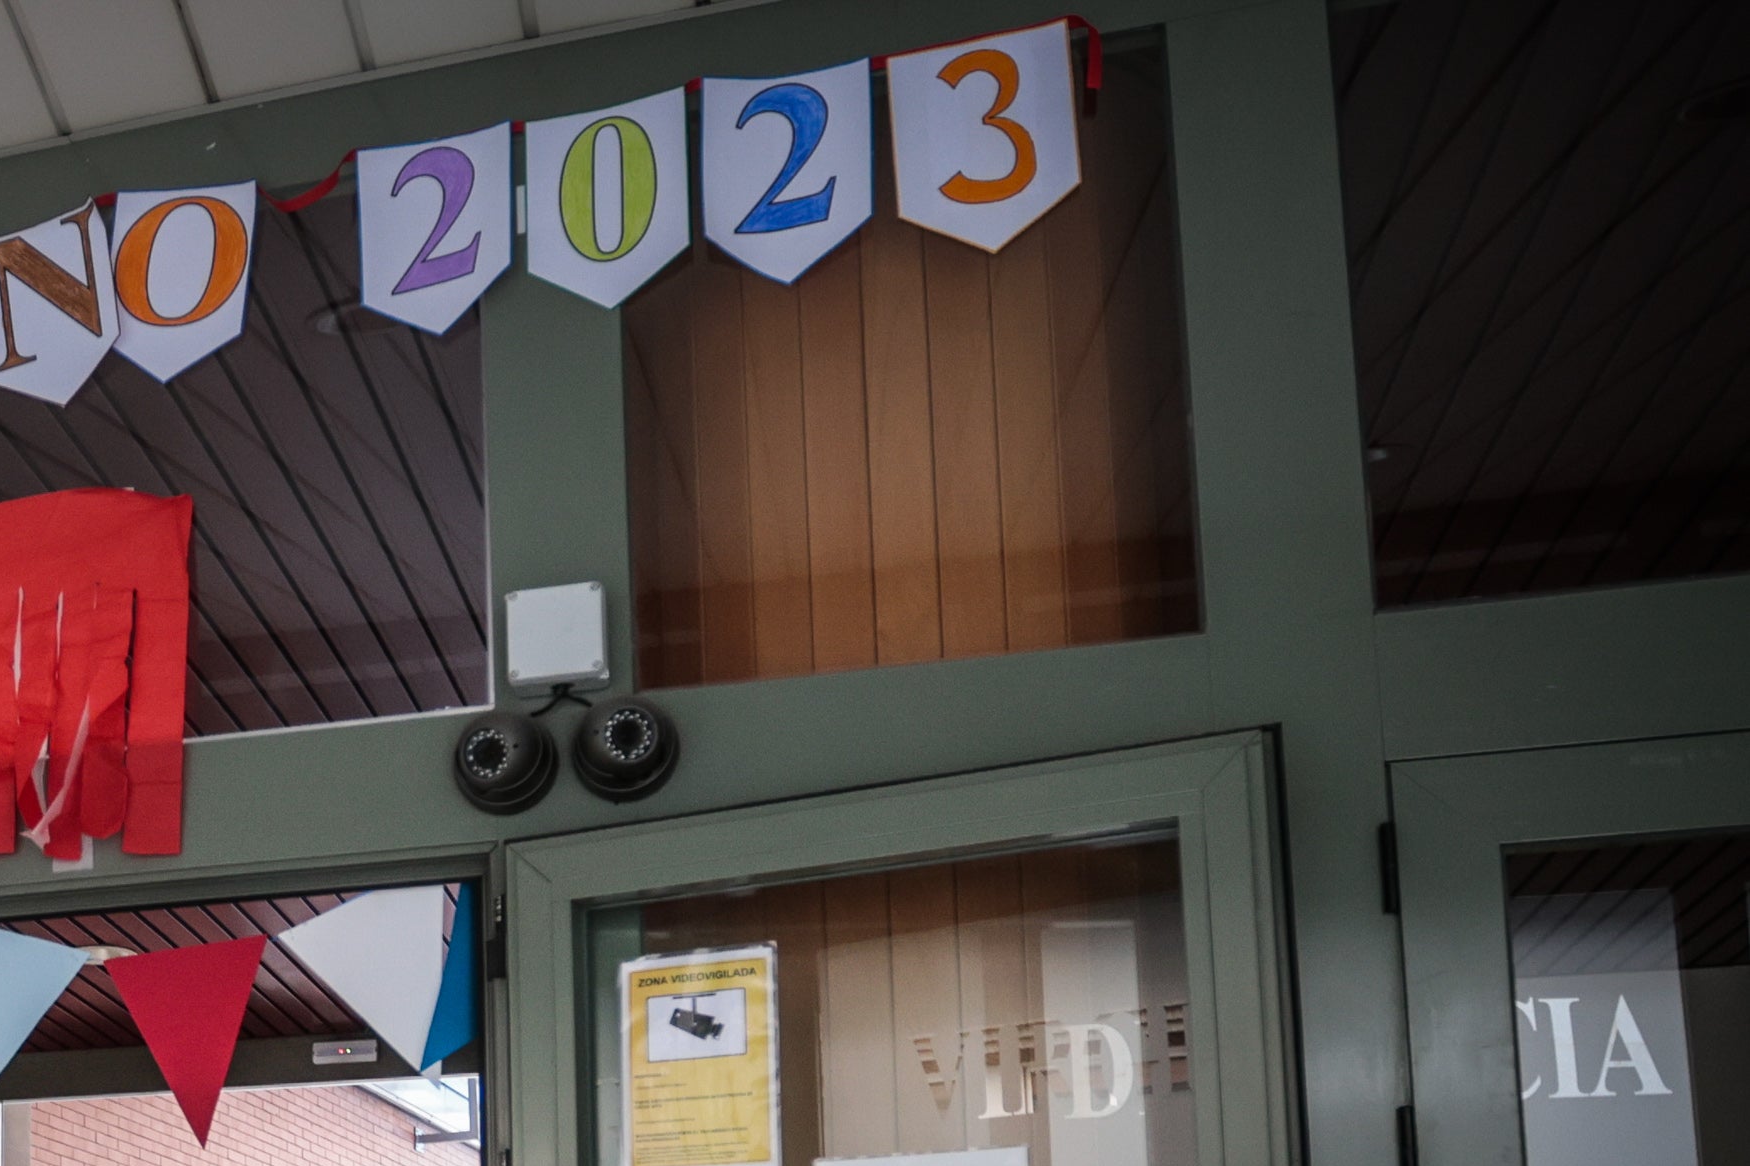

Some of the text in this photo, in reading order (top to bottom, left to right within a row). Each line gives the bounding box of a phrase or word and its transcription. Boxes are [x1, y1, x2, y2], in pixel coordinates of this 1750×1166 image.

[391, 48, 1037, 296] 2023
[638, 967, 758, 988] ZONA VIDEOVIGILADA
